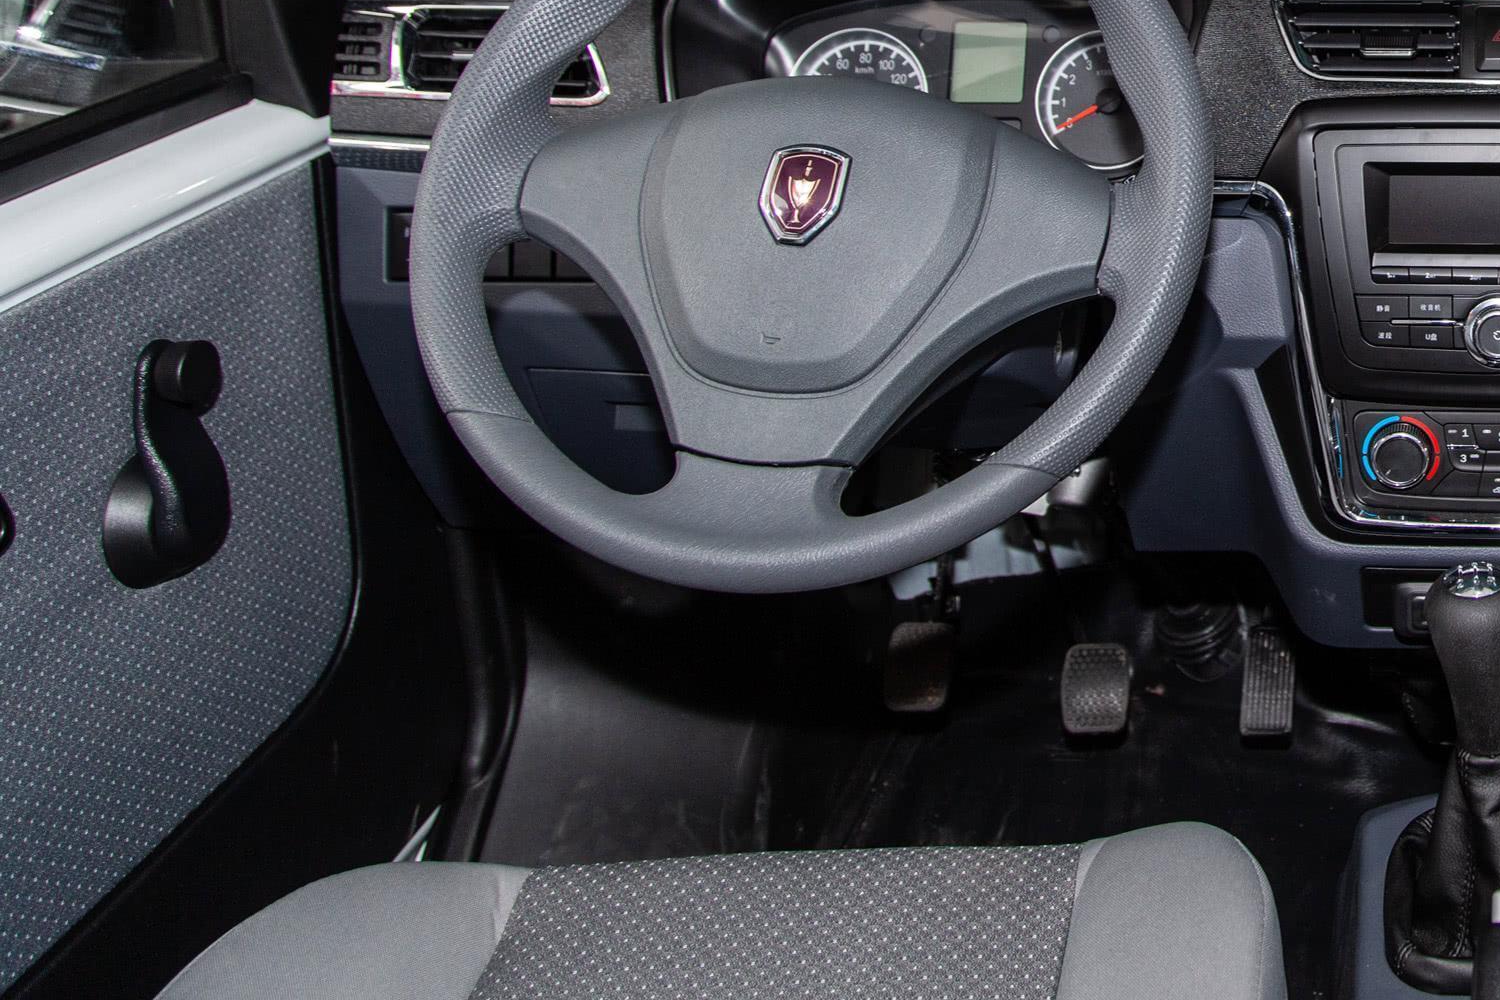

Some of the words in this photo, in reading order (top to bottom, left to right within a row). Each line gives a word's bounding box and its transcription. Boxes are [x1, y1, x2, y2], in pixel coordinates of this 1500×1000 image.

[859, 52, 872, 63] 80
[836, 59, 849, 70] 60
[879, 60, 895, 70] 100
[1086, 60, 1093, 71] 3
[855, 66, 874, 74] km/h
[890, 73, 907, 84] 120
[1069, 74, 1076, 85] 2
[1061, 97, 1066, 107] 1
[1425, 333, 1437, 341] U盘
[1462, 428, 1469, 438] 1
[1460, 454, 1467, 463] 3
